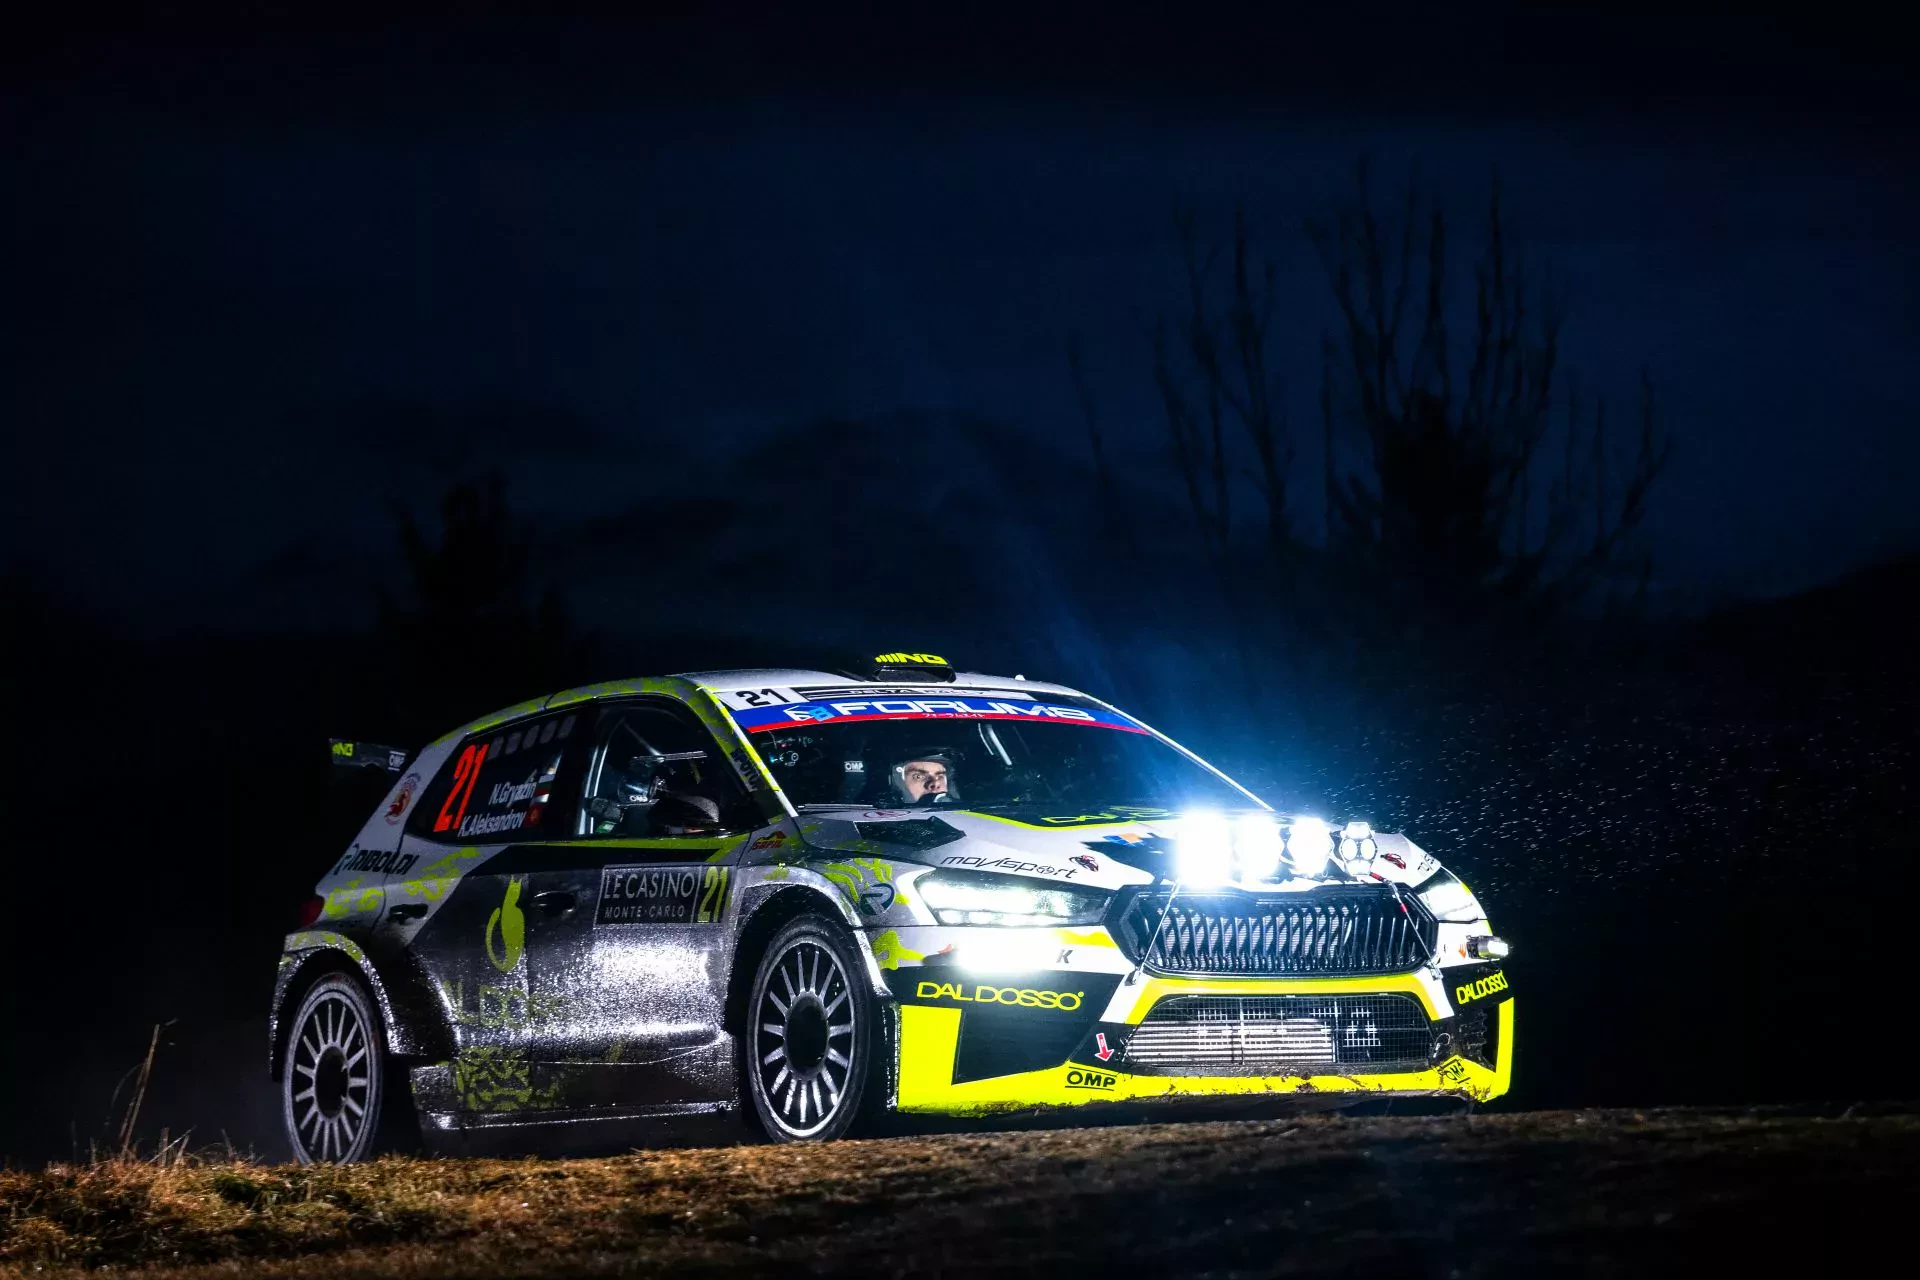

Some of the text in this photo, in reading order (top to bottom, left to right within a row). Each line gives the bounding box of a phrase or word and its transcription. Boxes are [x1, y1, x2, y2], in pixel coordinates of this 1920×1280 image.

[735, 688, 790, 707] 21
[433, 743, 490, 833] 21
[940, 856, 1079, 879] movisport
[604, 872, 695, 899] LE CASINO
[697, 866, 728, 924] 21
[1456, 970, 1509, 1005] DALDOSSO
[1066, 1070, 1117, 1089] OMP
